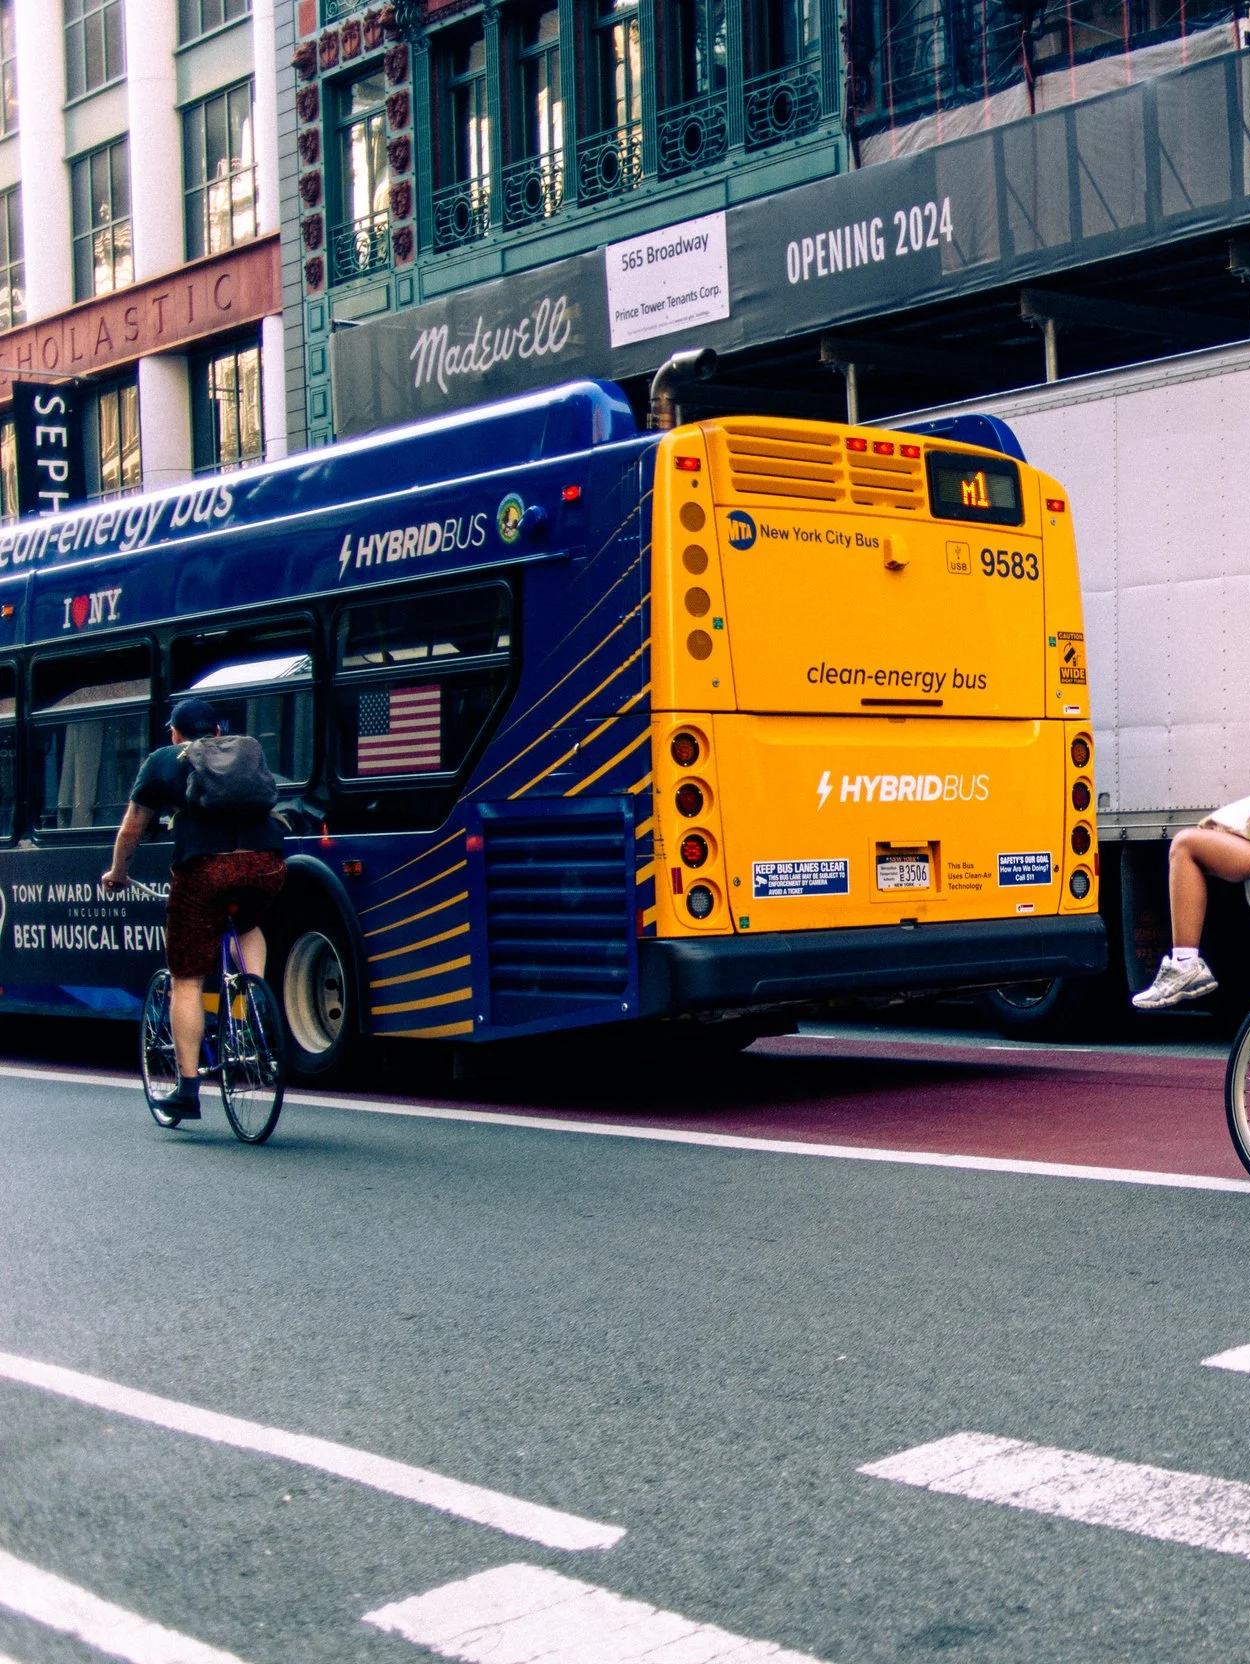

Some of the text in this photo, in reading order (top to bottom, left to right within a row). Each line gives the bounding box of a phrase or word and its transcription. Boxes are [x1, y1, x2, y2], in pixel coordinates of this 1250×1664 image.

[786, 196, 953, 284] OPENING 2024
[621, 233, 709, 272] 565 Broadway
[615, 284, 722, 322] Prince Tower Tenants Corp.
[0, 273, 233, 385] HOLASTIC
[410, 294, 571, 395] Madewell
[170, 483, 234, 528] bus
[355, 512, 488, 568] HYBRIDBUS
[728, 518, 879, 549] MTA New York City Bus
[950, 562, 968, 572] USB
[980, 547, 1040, 581] 9583
[1058, 632, 1083, 641] CAUTION
[806, 661, 988, 694] clean-energy bus
[1061, 667, 1086, 679] WIDE
[839, 773, 990, 803] HYBRIDBUS
[755, 861, 845, 875] KEEP BUS LANES CLEAR
[999, 855, 1049, 865] SAFETY'S OUR GOAL
[1031, 864, 1049, 872] Doing?
[905, 864, 927, 882] 3506
[964, 871, 992, 880] Clean-Air
[12, 884, 43, 903] TONY
[47, 883, 92, 903] AWARD
[768, 880, 801, 888] ENFORCEMENT
[768, 888, 783, 896] AVOID
[947, 882, 983, 890] Technology
[68, 907, 127, 918] INCLUDING
[13, 924, 46, 949] BEST
[51, 924, 119, 950] MUSICAL
